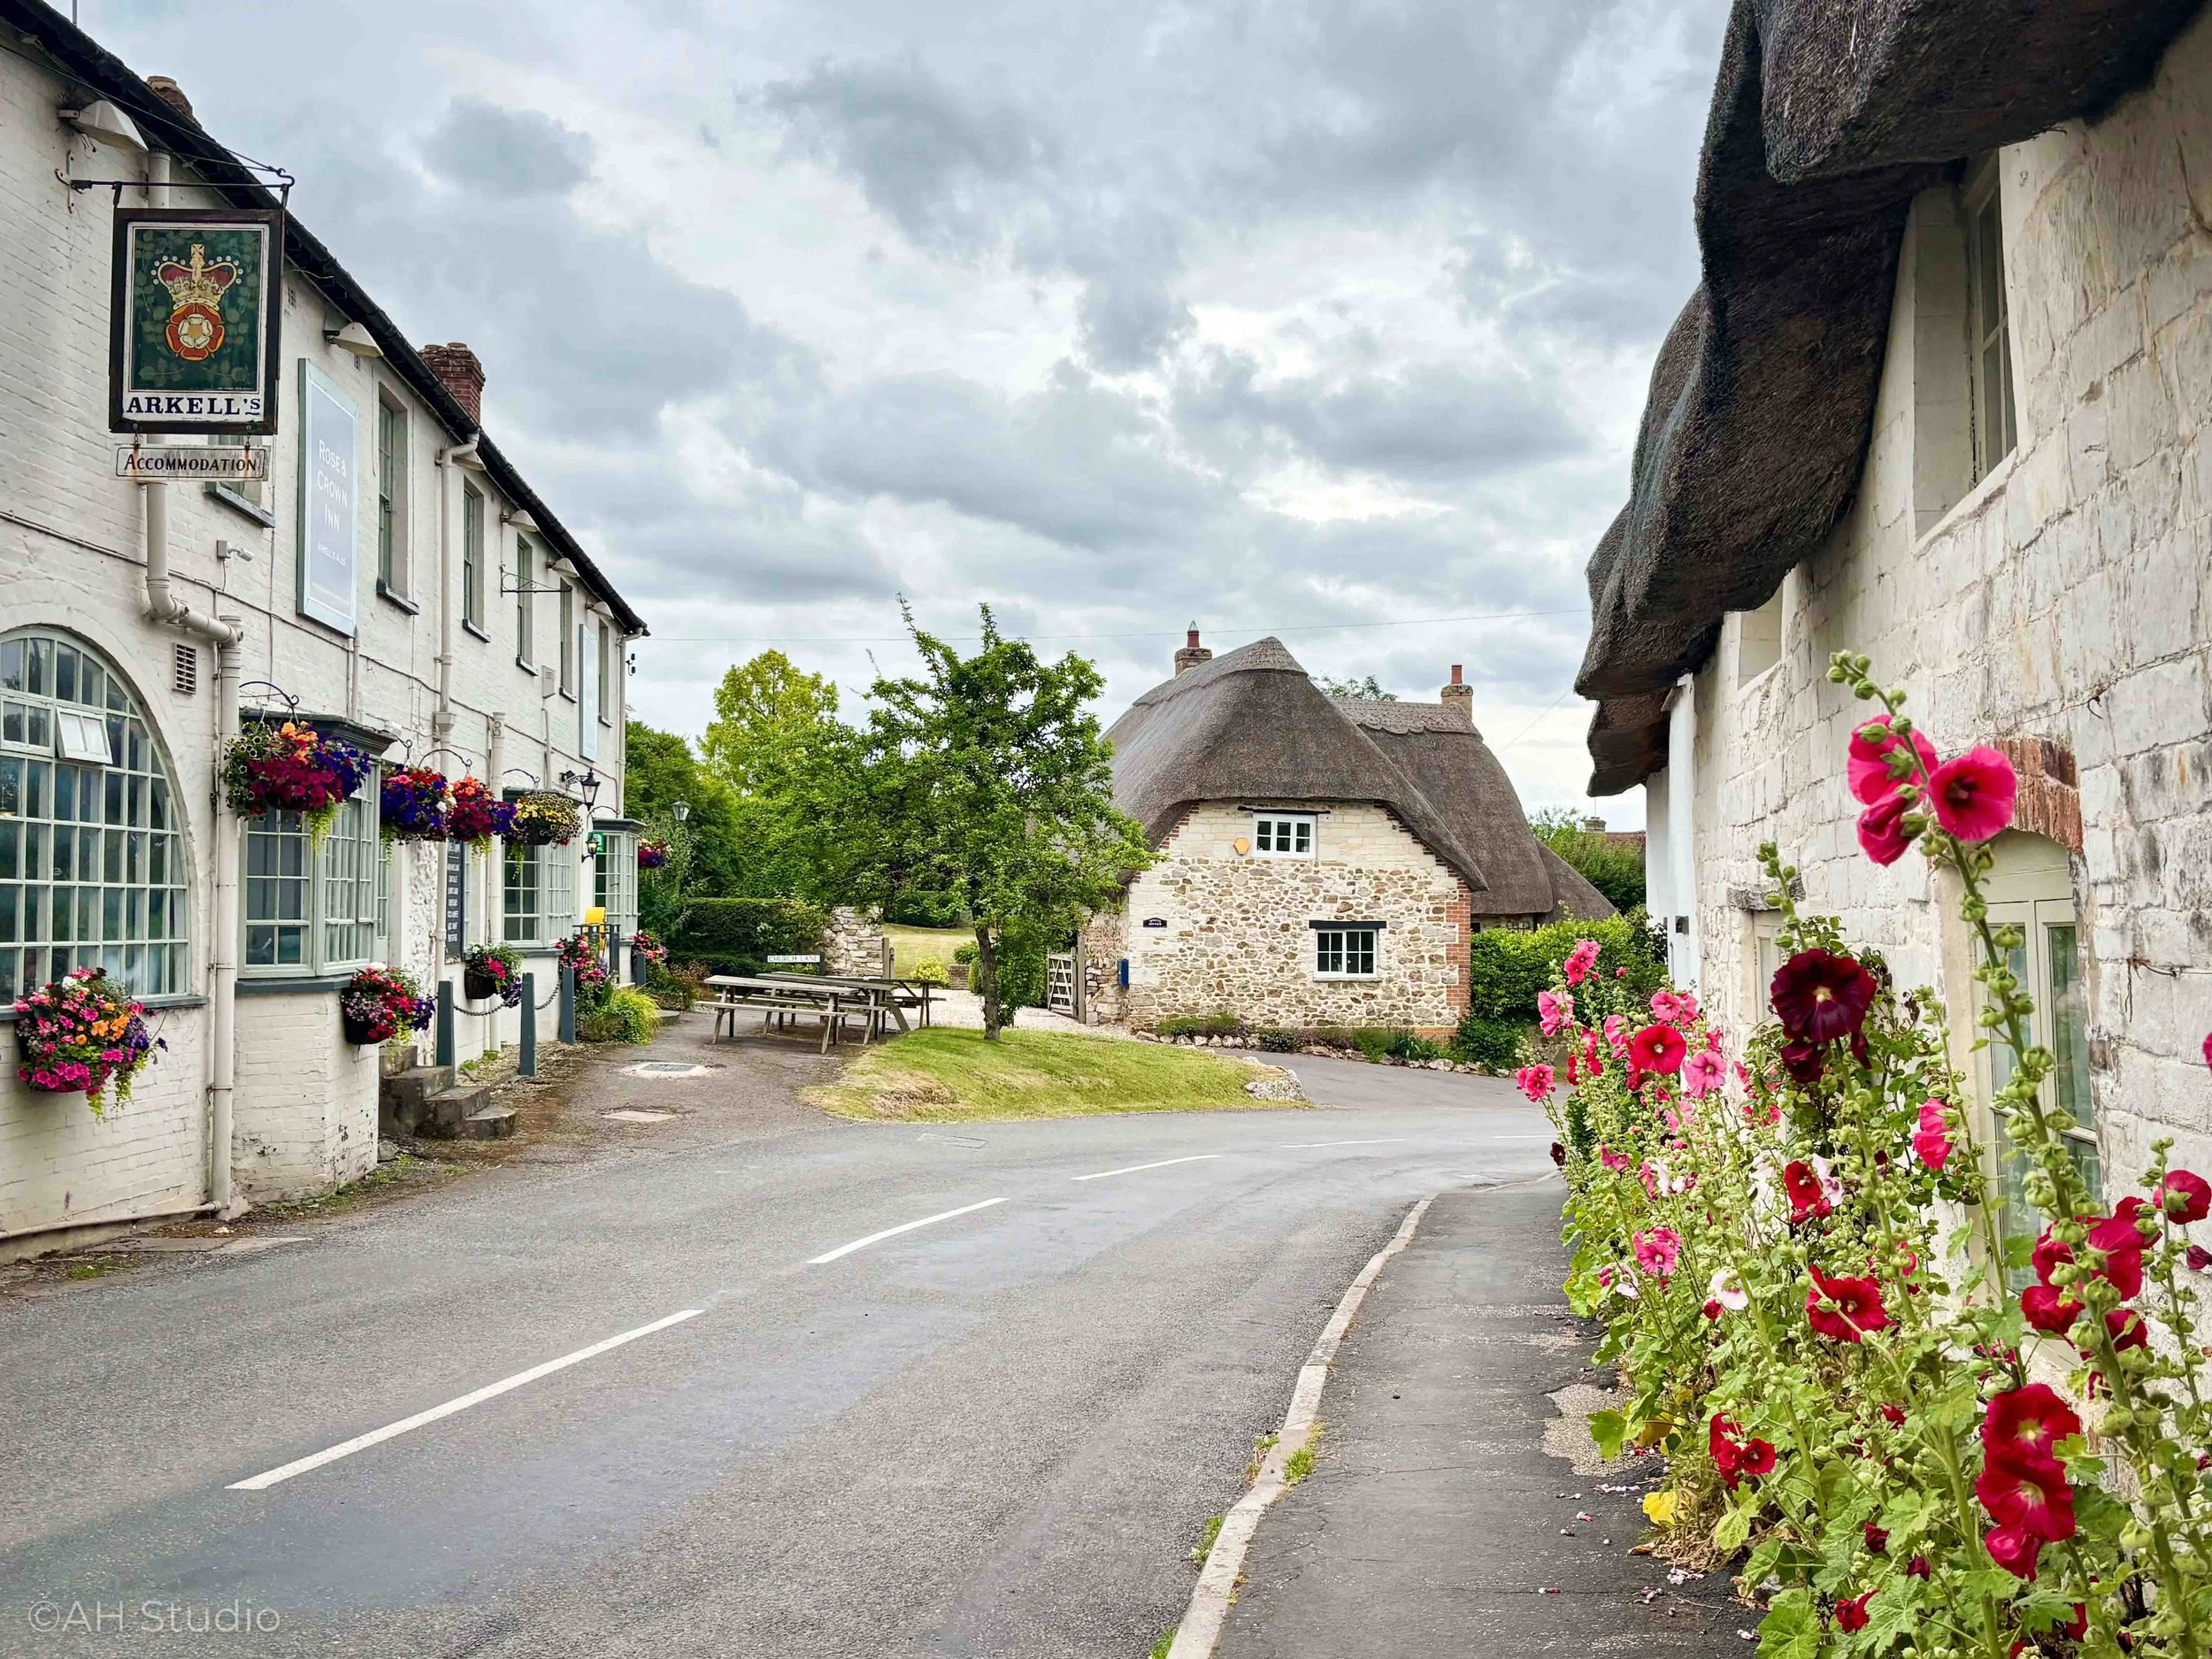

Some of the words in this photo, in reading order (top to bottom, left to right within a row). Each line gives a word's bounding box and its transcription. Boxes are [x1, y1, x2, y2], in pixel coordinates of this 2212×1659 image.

[126, 396, 261, 415] ARKELL'S
[124, 453, 257, 472] ACCOMMODATION
[318, 470, 348, 508] CROWN
[325, 503, 340, 531] INN
